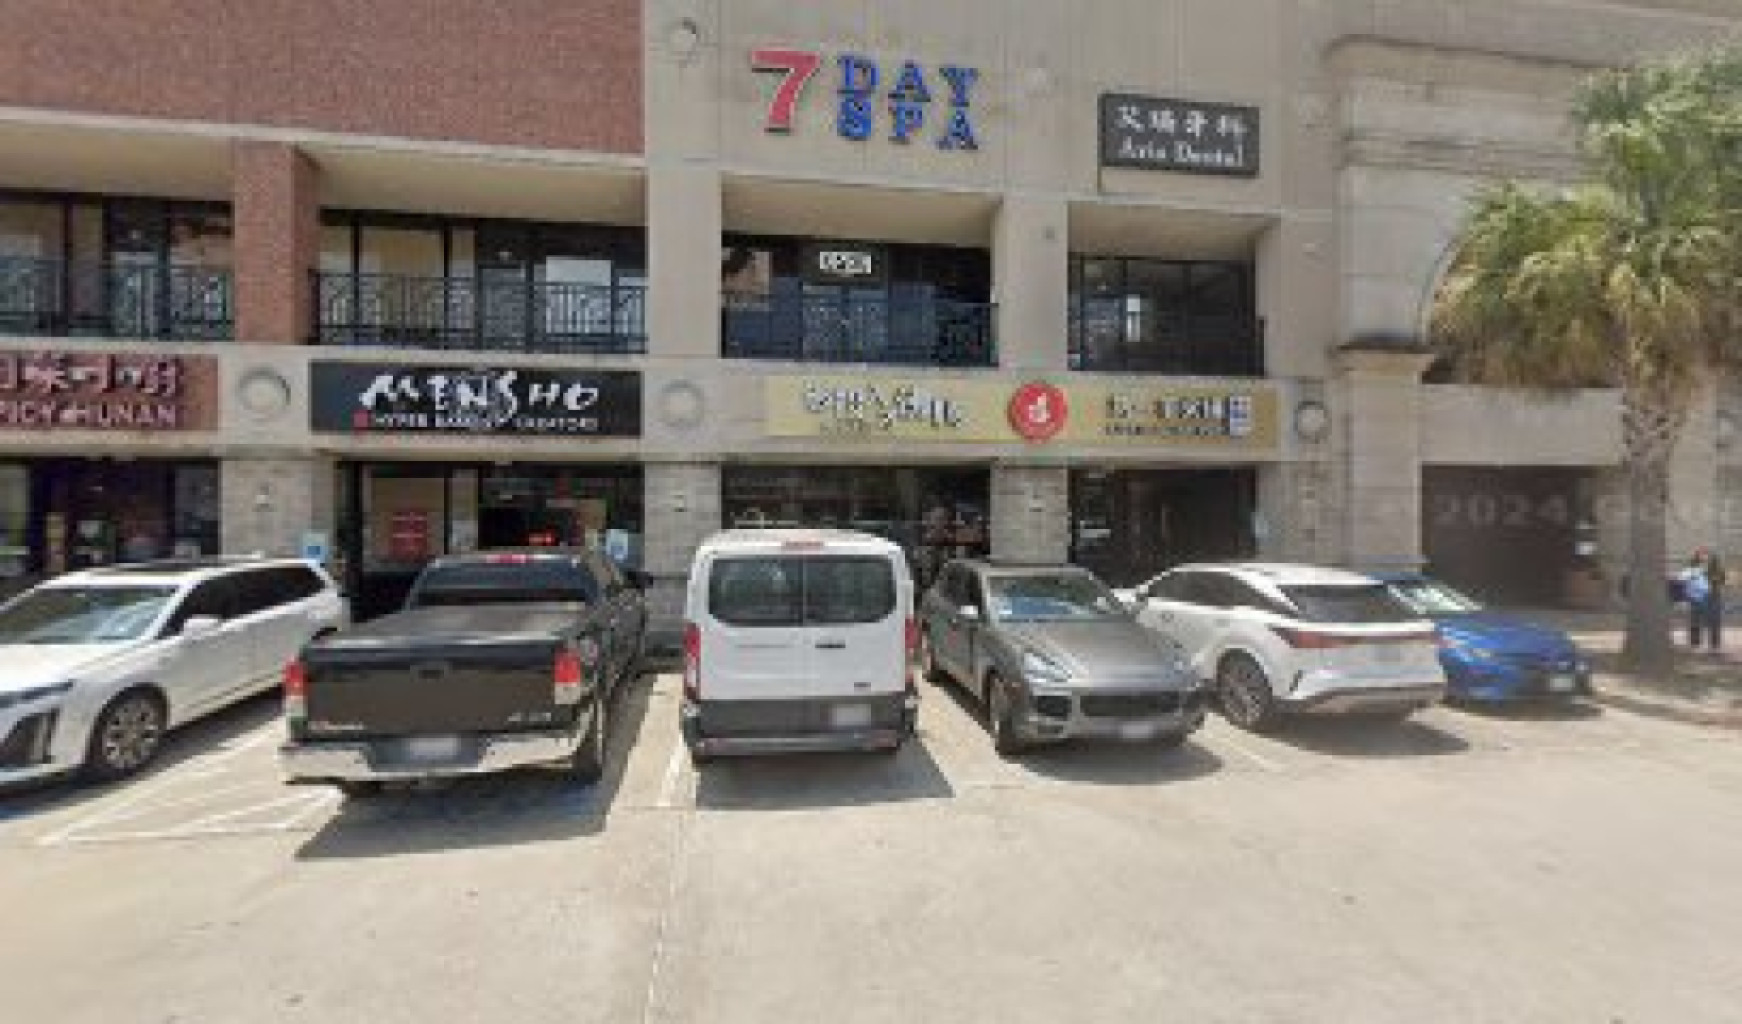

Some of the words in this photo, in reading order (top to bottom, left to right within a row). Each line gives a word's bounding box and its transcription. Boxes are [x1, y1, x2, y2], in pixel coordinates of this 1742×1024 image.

[751, 49, 820, 135] 7
[836, 55, 980, 108] DAY
[836, 99, 980, 151] SPA
[1173, 140, 1243, 168] Dental
[79, 402, 177, 428] HUNAN
[357, 370, 600, 422] MENSHO
